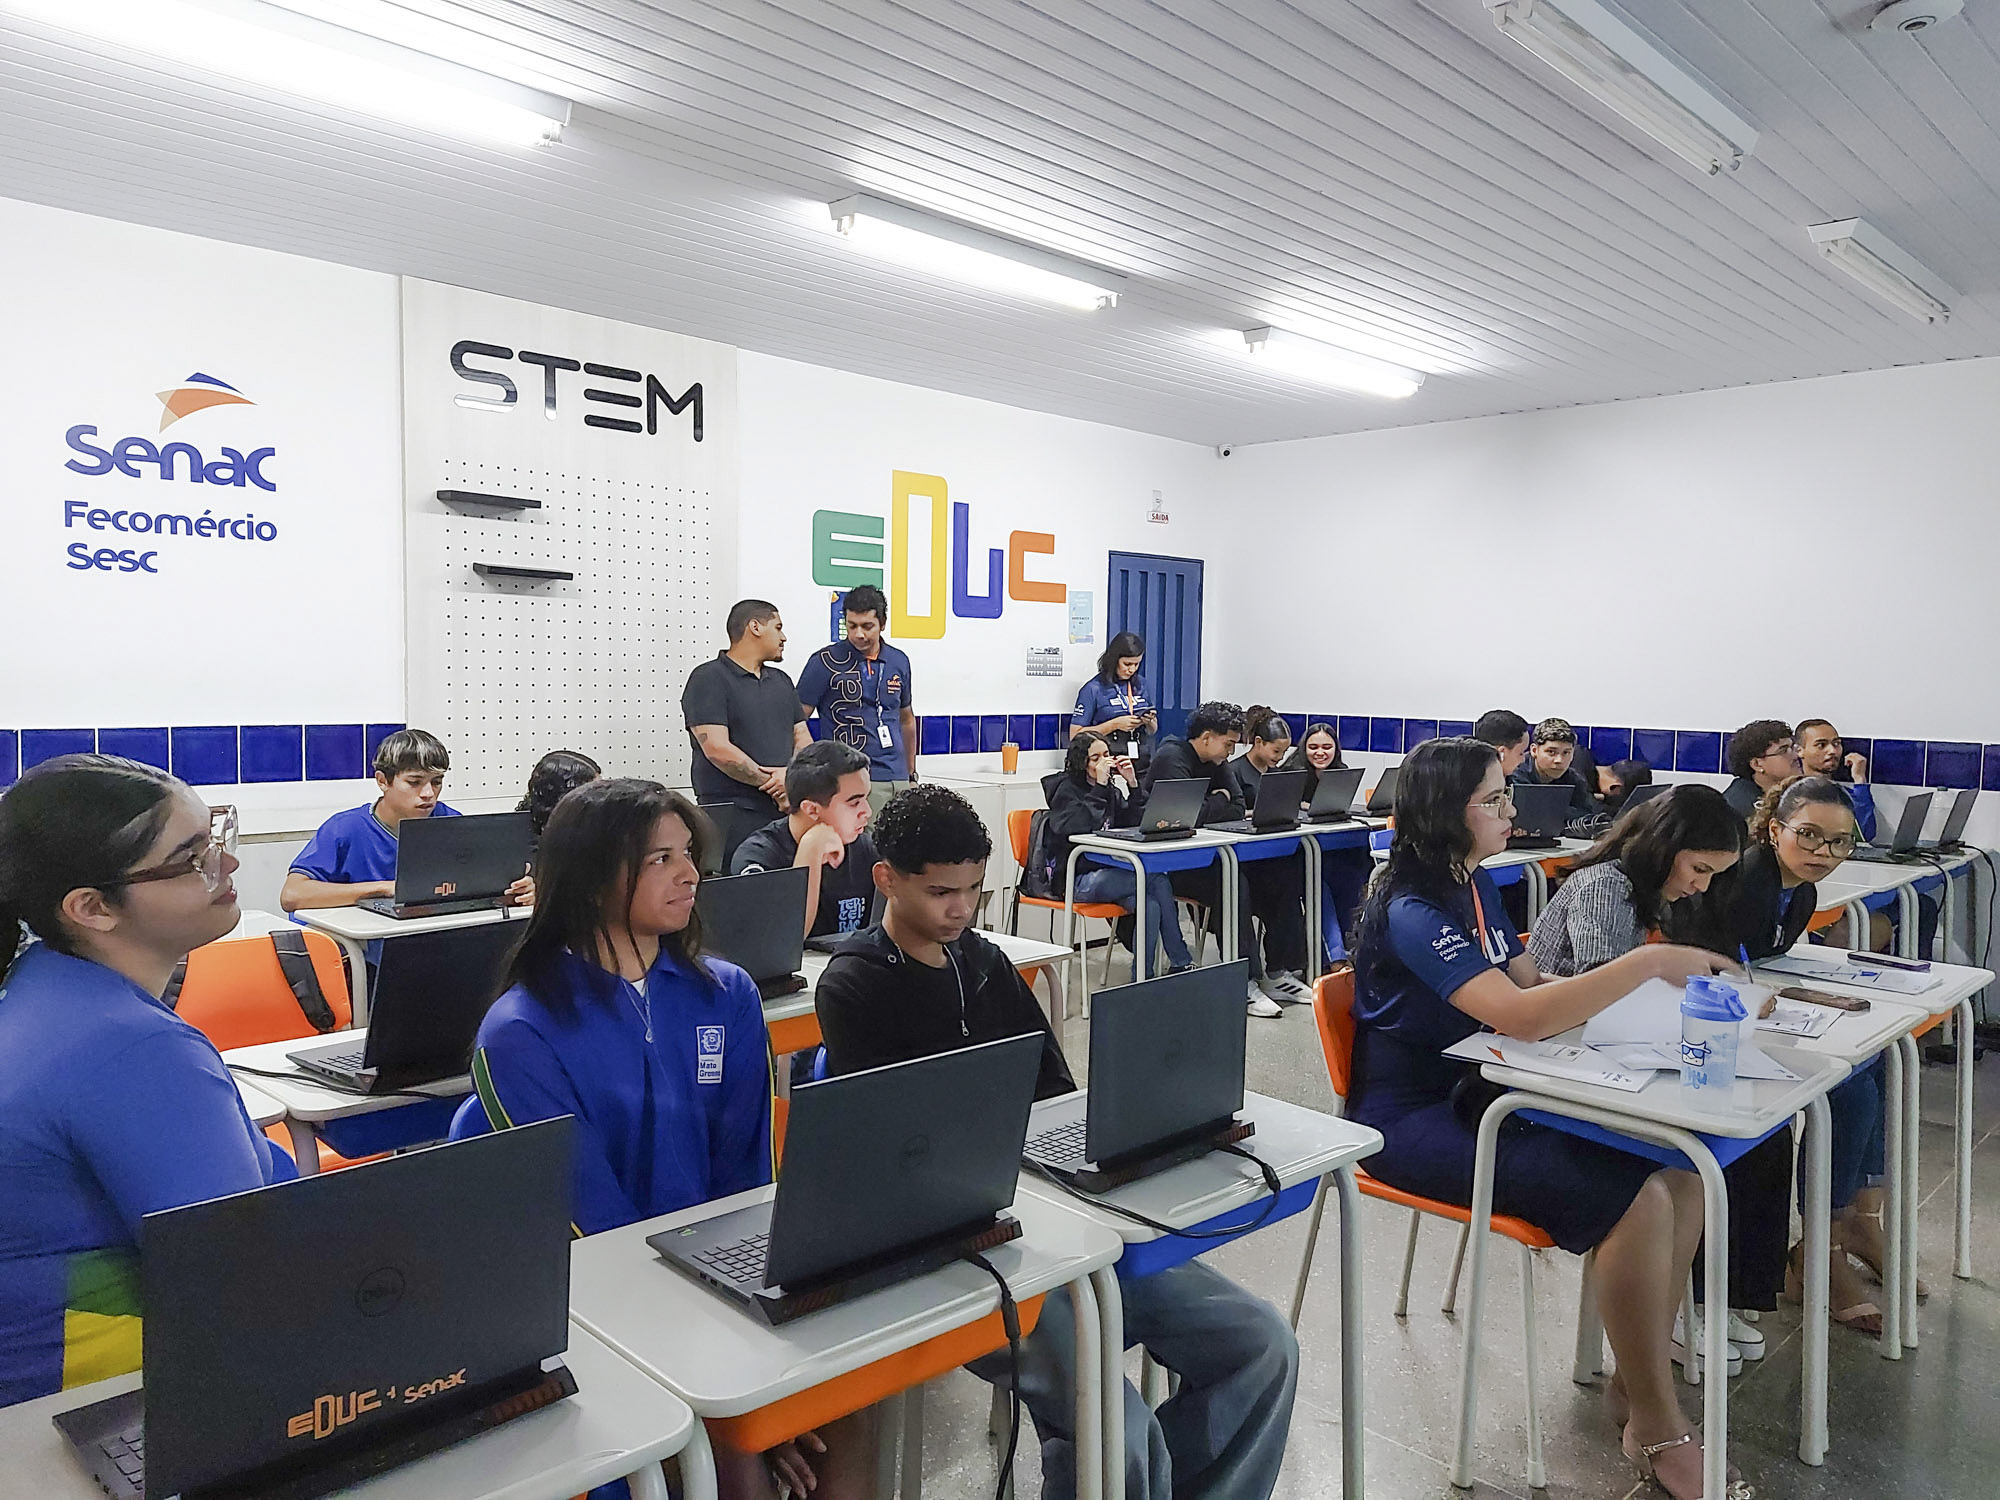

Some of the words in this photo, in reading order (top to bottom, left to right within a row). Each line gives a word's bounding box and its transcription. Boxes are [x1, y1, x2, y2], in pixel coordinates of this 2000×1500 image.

[450, 340, 703, 442] STEM
[65, 424, 277, 492] Senac
[65, 500, 278, 541] Fecomércio
[66, 542, 158, 573] Sesc
[812, 469, 1067, 640] EDUC
[821, 650, 867, 752] enac
